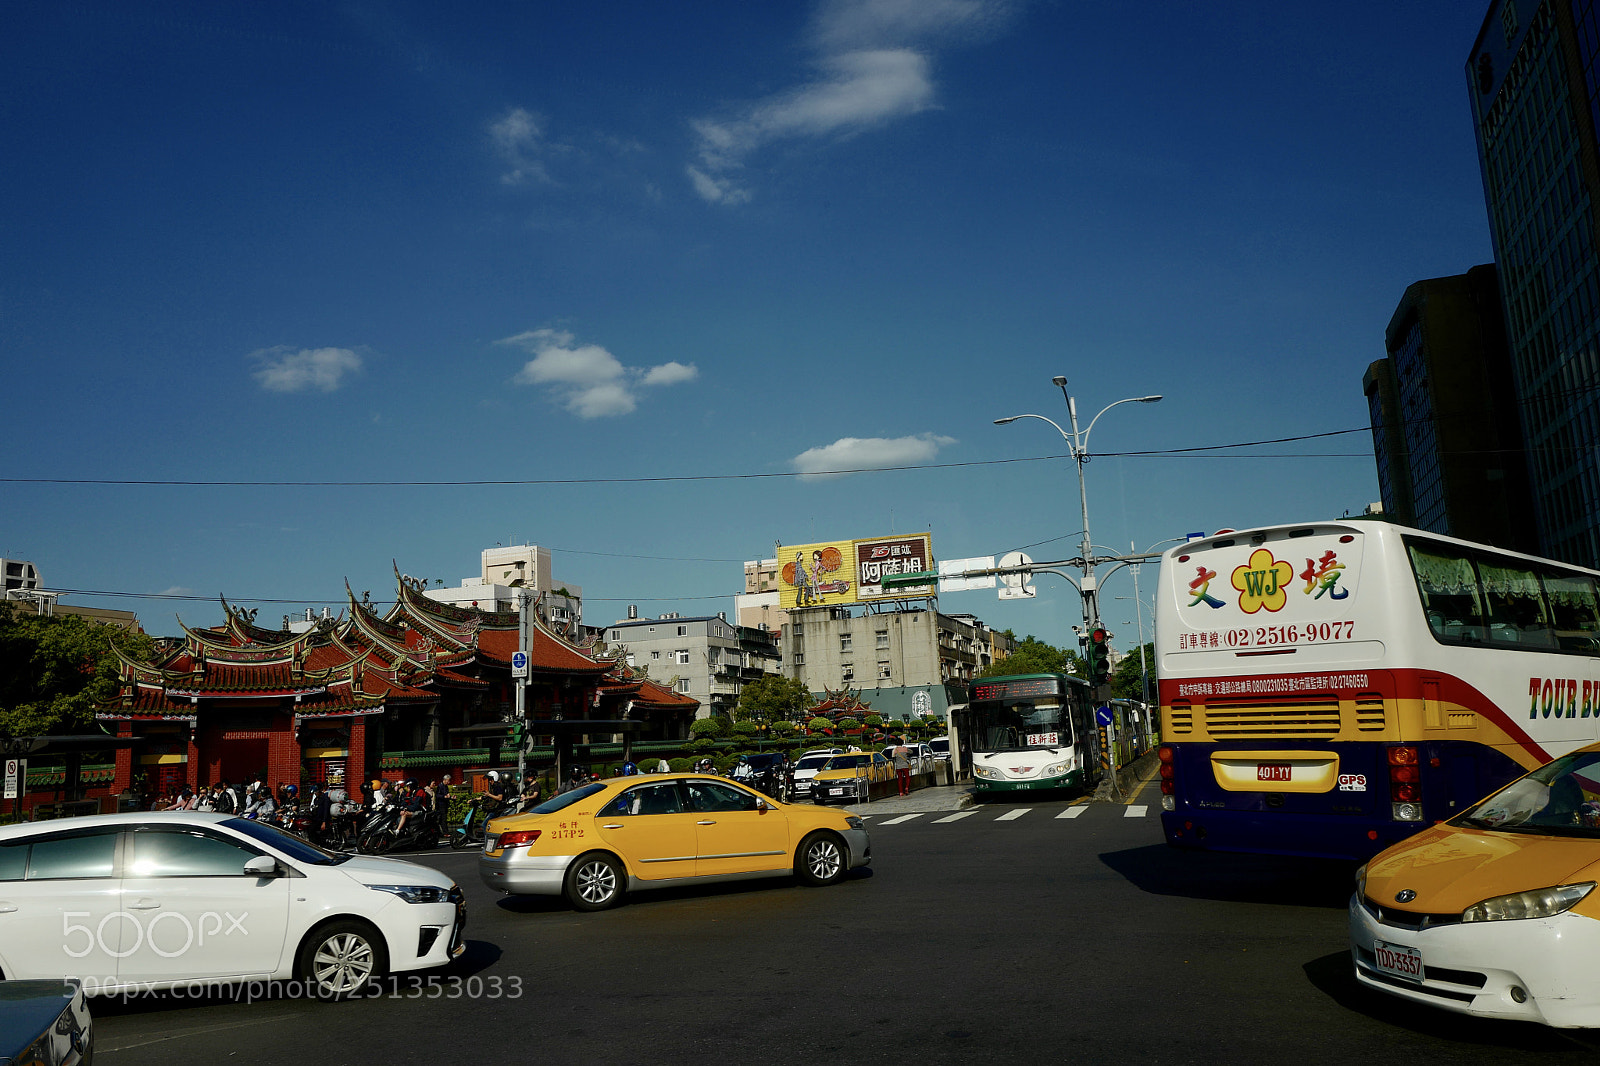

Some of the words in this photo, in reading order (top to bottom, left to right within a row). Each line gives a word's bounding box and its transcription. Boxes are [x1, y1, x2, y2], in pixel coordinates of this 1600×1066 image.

[1187, 566, 1226, 609] 文
[1244, 569, 1279, 597] WJ
[1300, 550, 1349, 600] 境
[1529, 677, 1577, 719] TOUR
[1258, 767, 1290, 779] 401-YY
[1340, 775, 1366, 785] GPS
[1376, 948, 1421, 976] TDD-3337
